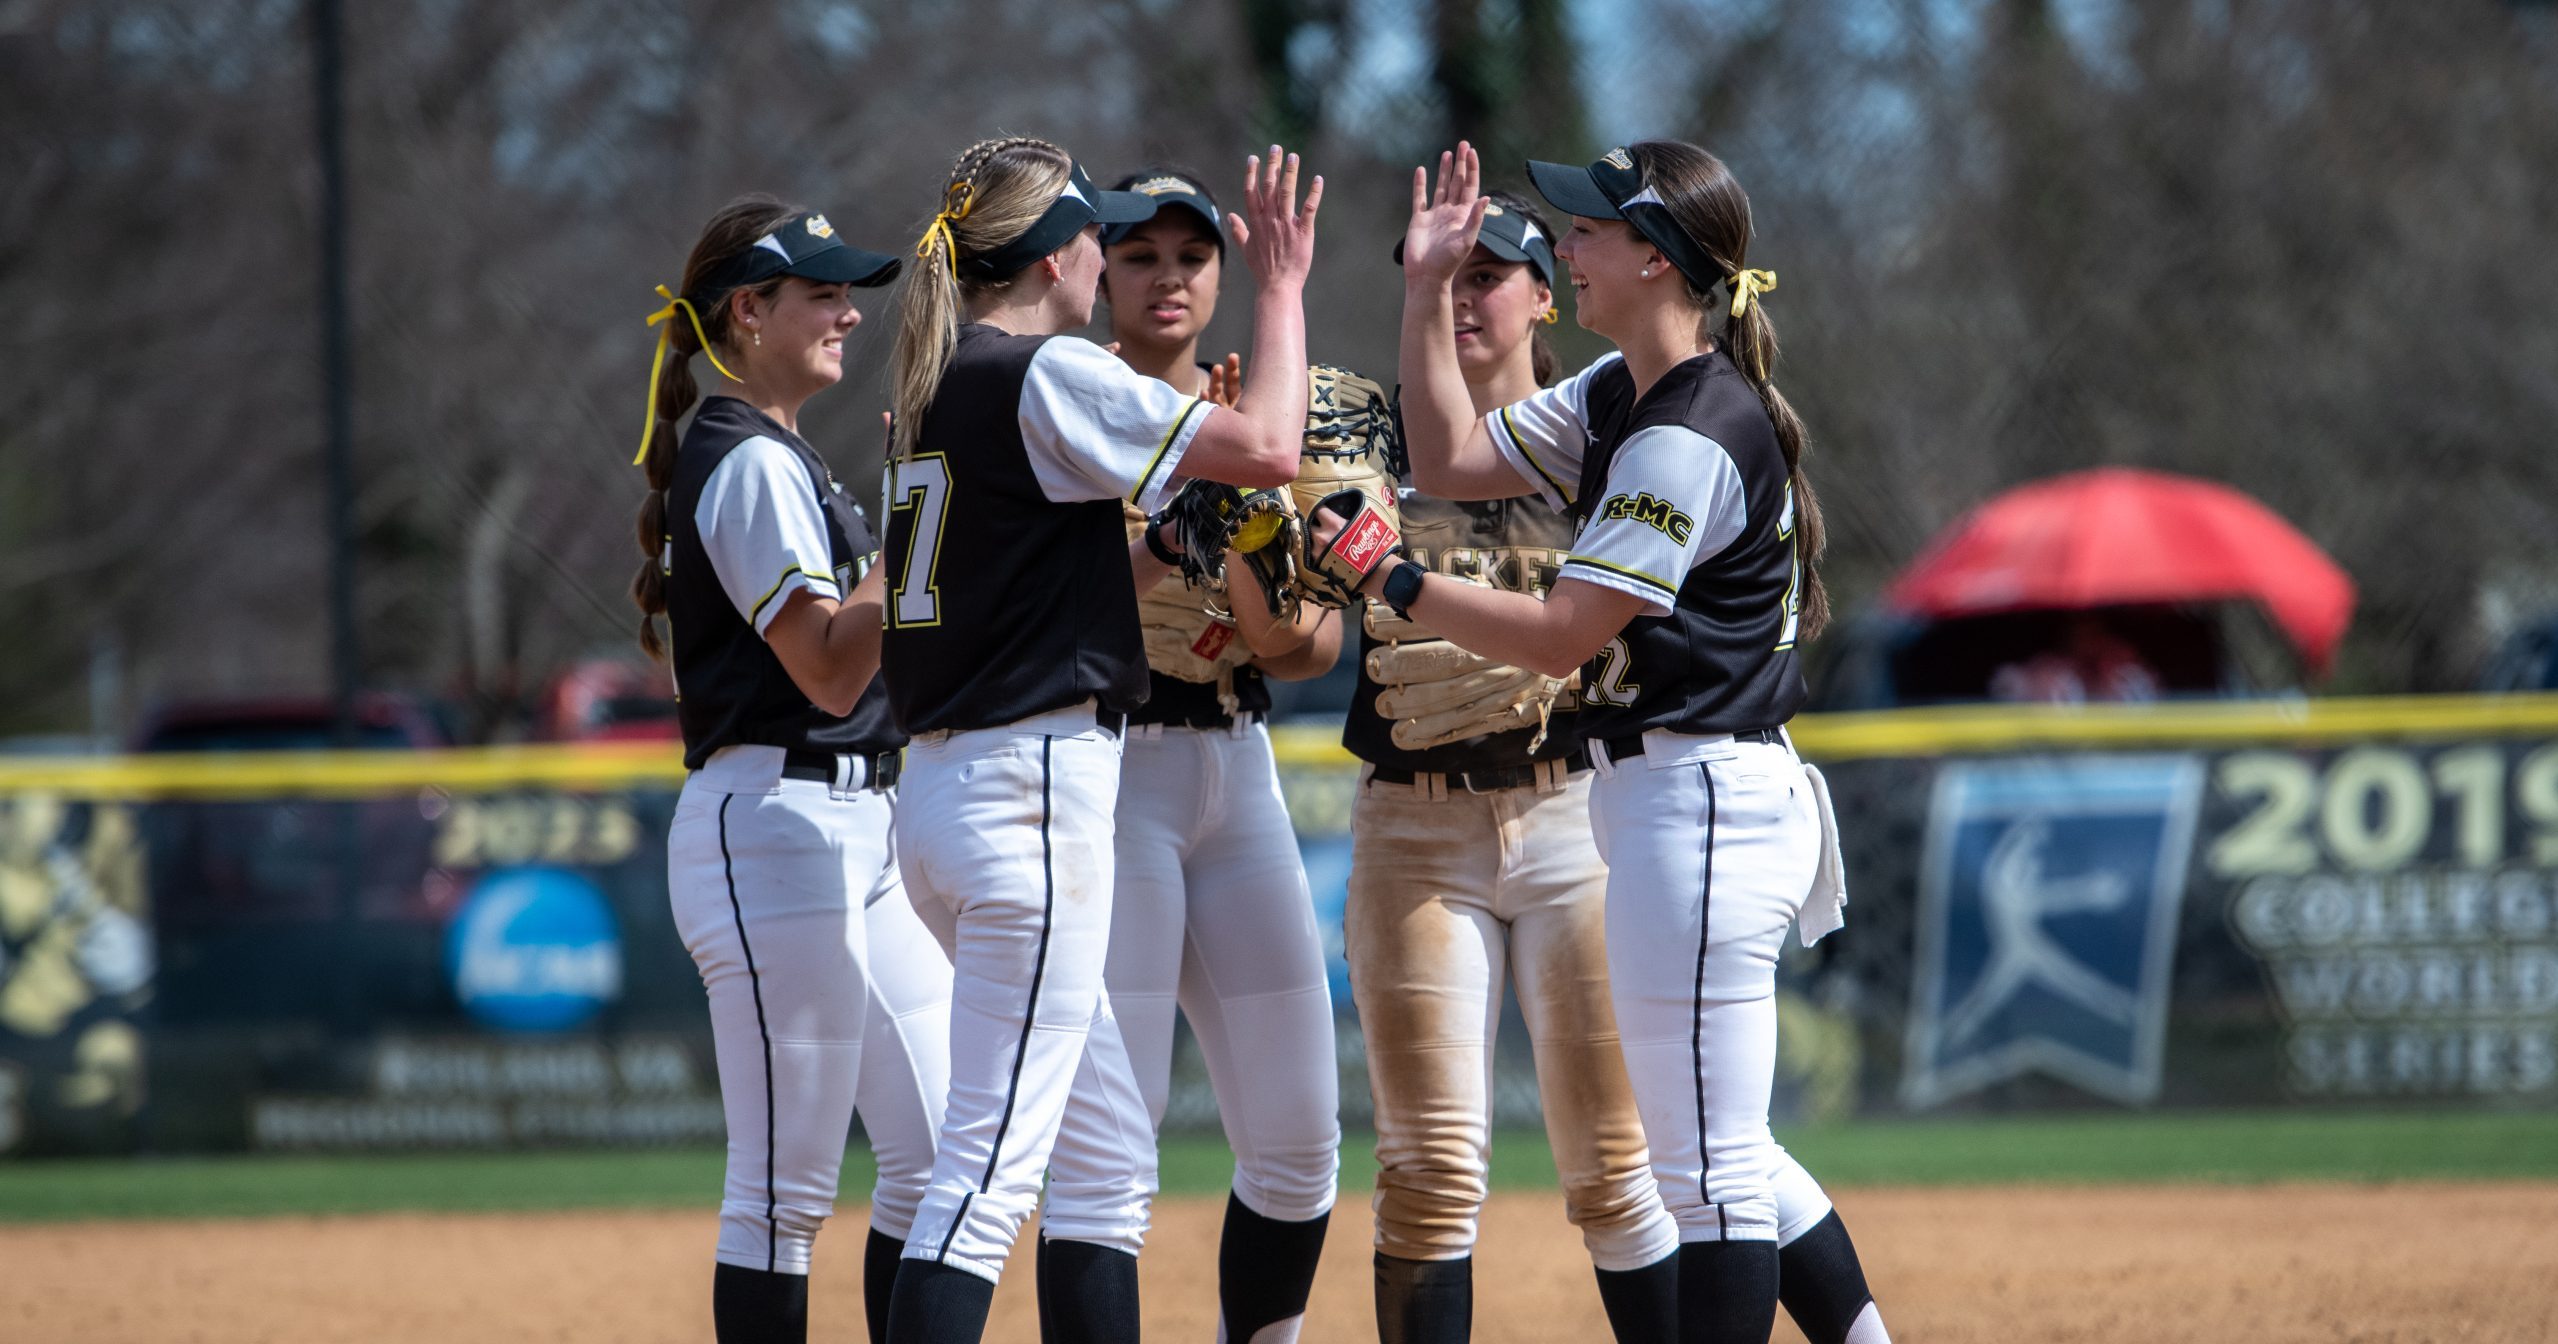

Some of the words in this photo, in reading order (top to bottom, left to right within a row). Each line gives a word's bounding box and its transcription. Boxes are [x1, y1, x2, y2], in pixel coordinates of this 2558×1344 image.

[882, 450, 953, 629] 7
[1349, 520, 1381, 561] Rawlings
[1596, 492, 1695, 547] R-MC
[1584, 634, 1640, 708] 2
